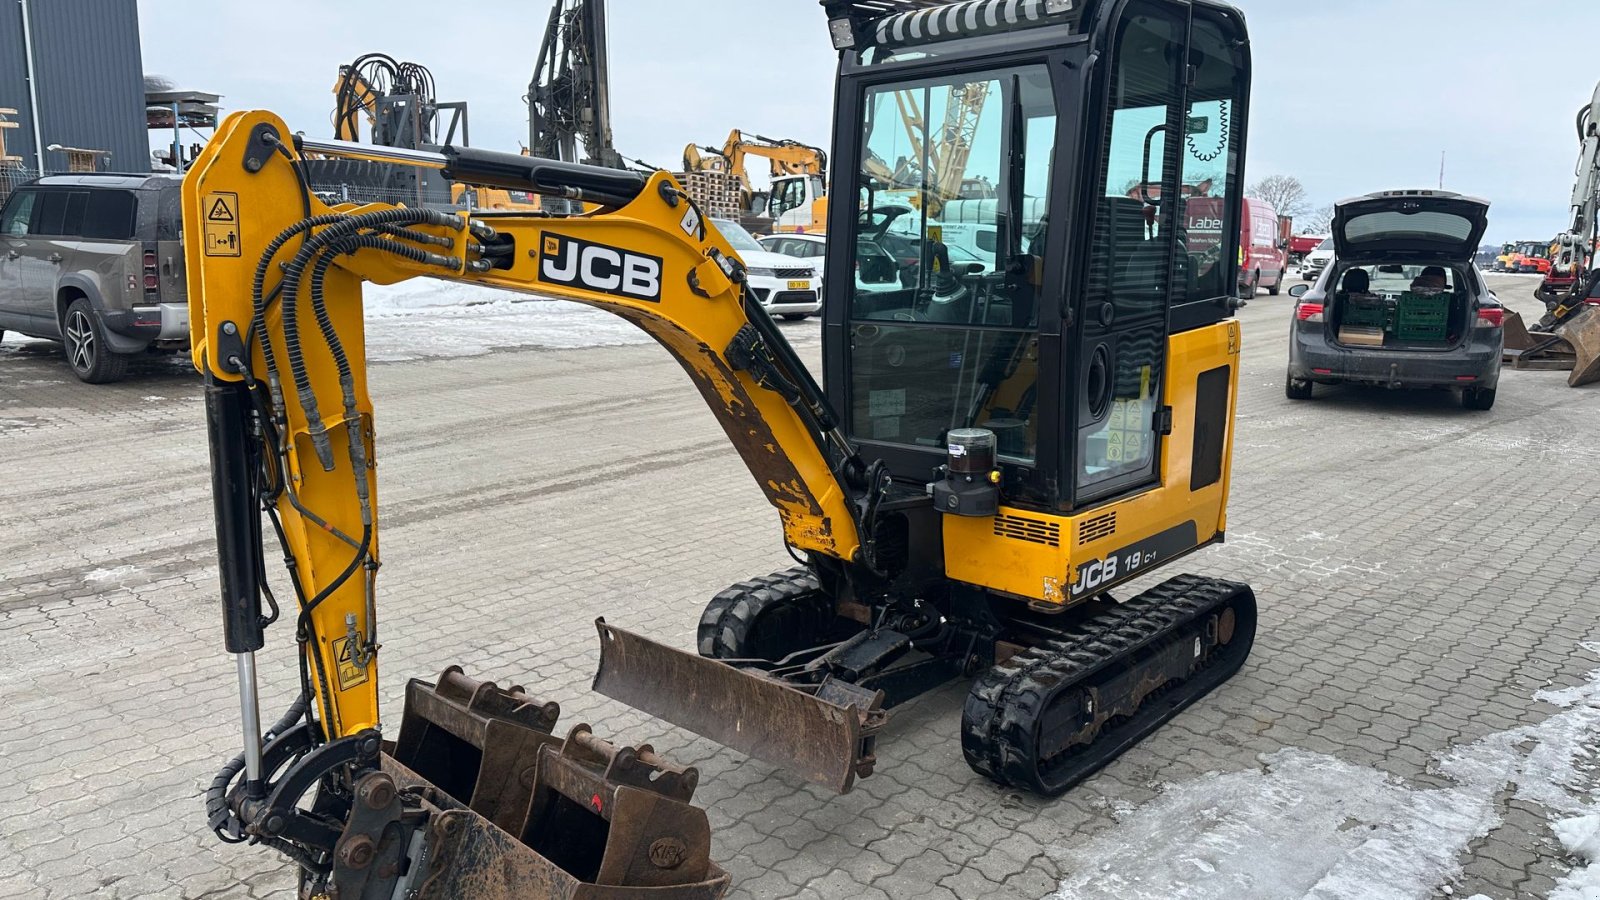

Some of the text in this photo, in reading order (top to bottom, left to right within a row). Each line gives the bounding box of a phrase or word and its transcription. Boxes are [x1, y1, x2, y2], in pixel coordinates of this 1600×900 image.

[542, 241, 660, 297] JCB
[1072, 555, 1118, 595] JCB
[1125, 551, 1141, 572] 19
[652, 842, 686, 863] KIRK
